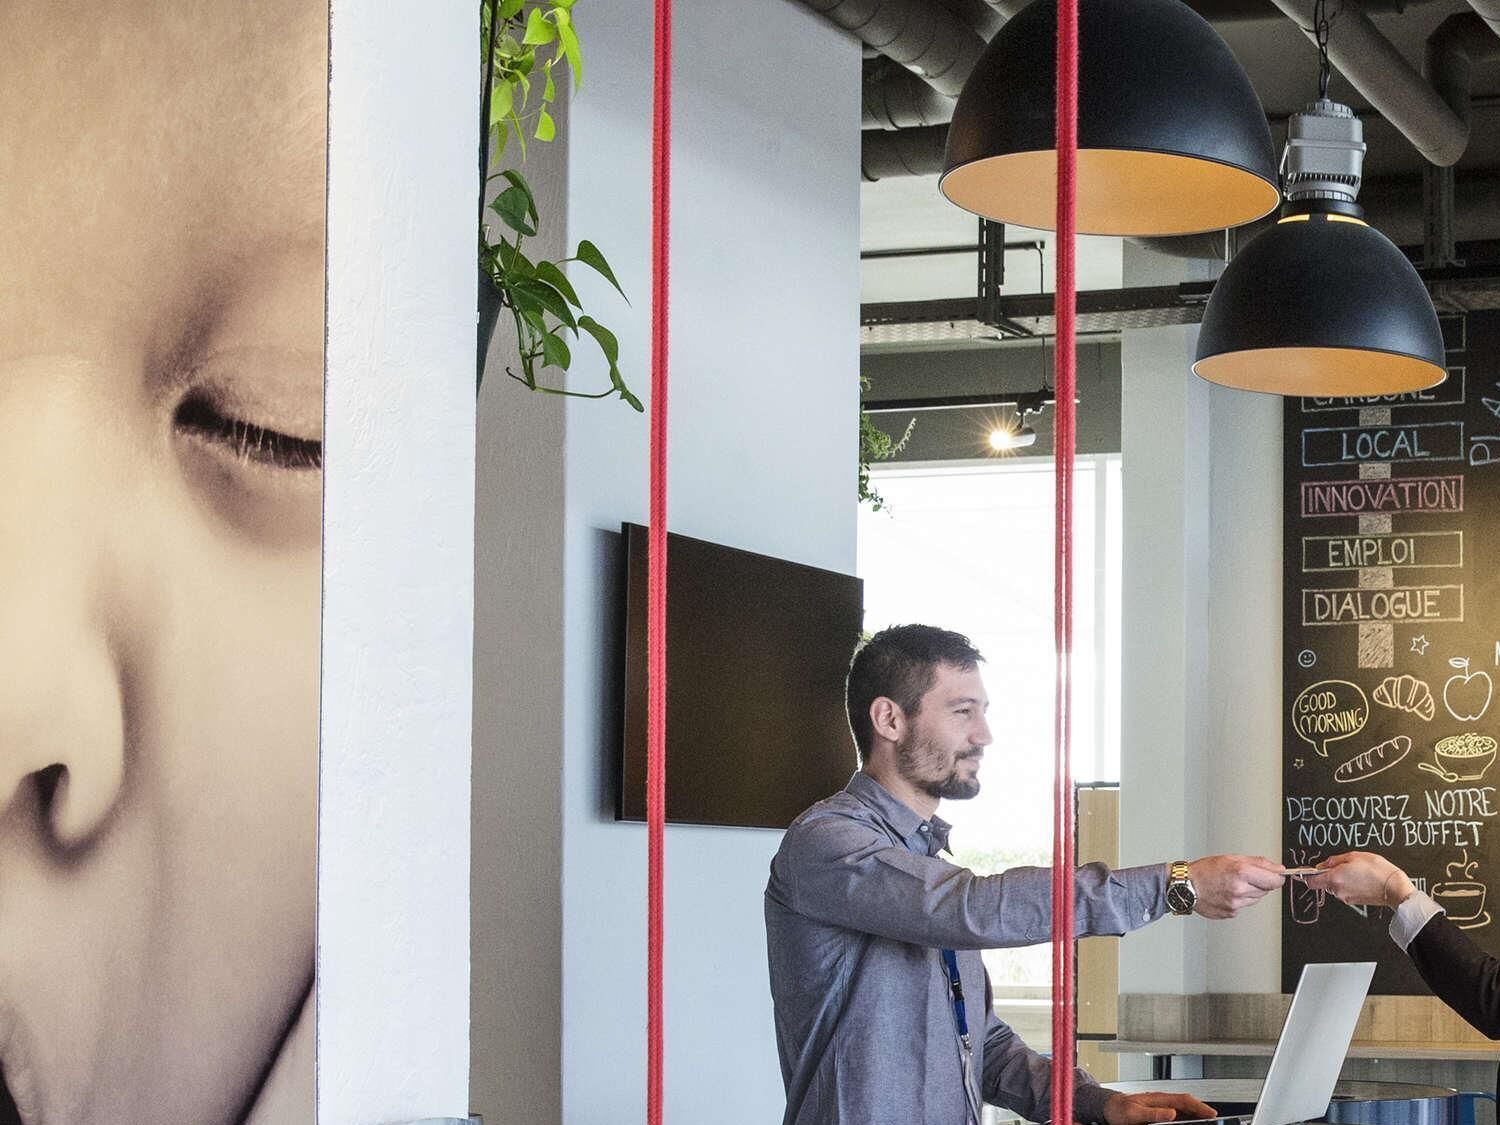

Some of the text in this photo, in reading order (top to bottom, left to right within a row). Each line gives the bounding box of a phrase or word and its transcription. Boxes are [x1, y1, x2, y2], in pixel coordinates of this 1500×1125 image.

[1341, 430, 1430, 461] LOCAL
[1307, 480, 1458, 513] INNOVATION
[1327, 539, 1415, 568] EMPLOI
[1313, 590, 1441, 620] DIALOGUE
[1298, 691, 1337, 712] GOOD
[1299, 707, 1364, 734] MORNING
[1287, 787, 1498, 822] DECOUVREZ NOTRE
[1297, 820, 1484, 847] NOUVEAU BUFFET
